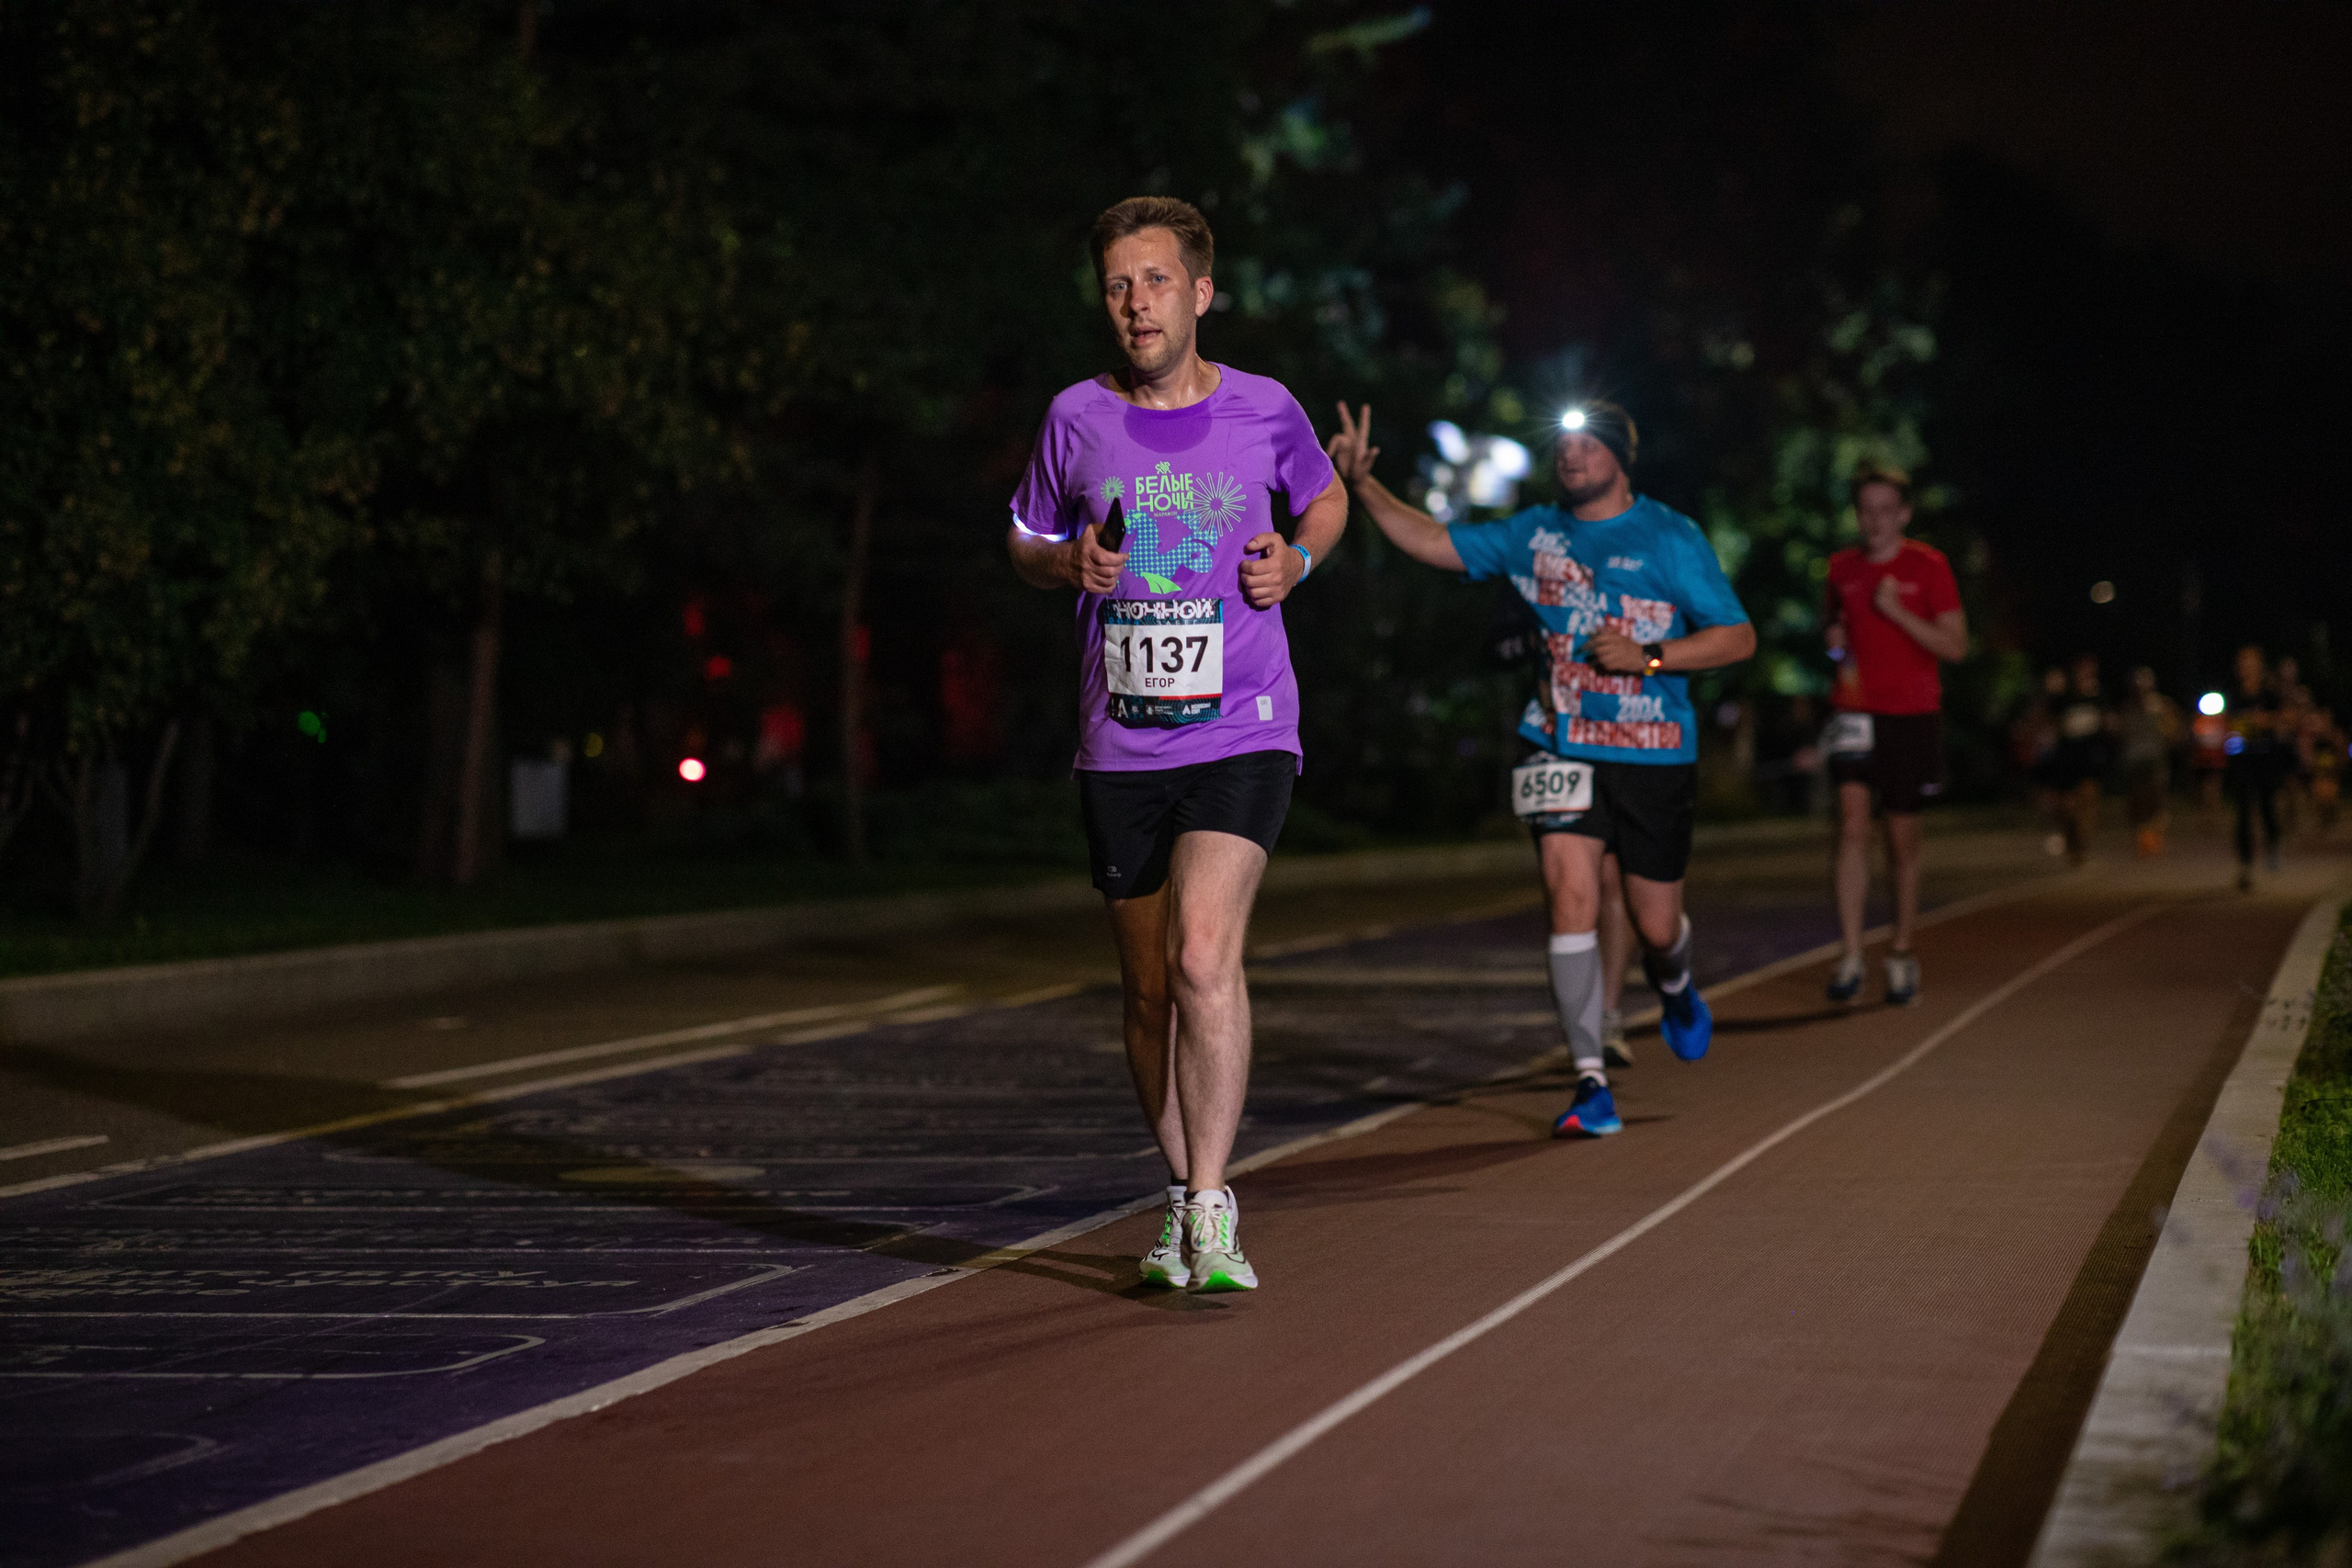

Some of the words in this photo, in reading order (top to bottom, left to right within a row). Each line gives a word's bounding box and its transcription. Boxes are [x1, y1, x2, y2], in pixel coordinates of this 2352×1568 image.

[1136, 473, 1193, 494] БЕЛЫЕ
[1136, 491, 1194, 513] НОЧИ
[1120, 636, 1209, 673] 1137
[1145, 678, 1175, 689] ЕГОР
[1521, 771, 1581, 799] 6509
